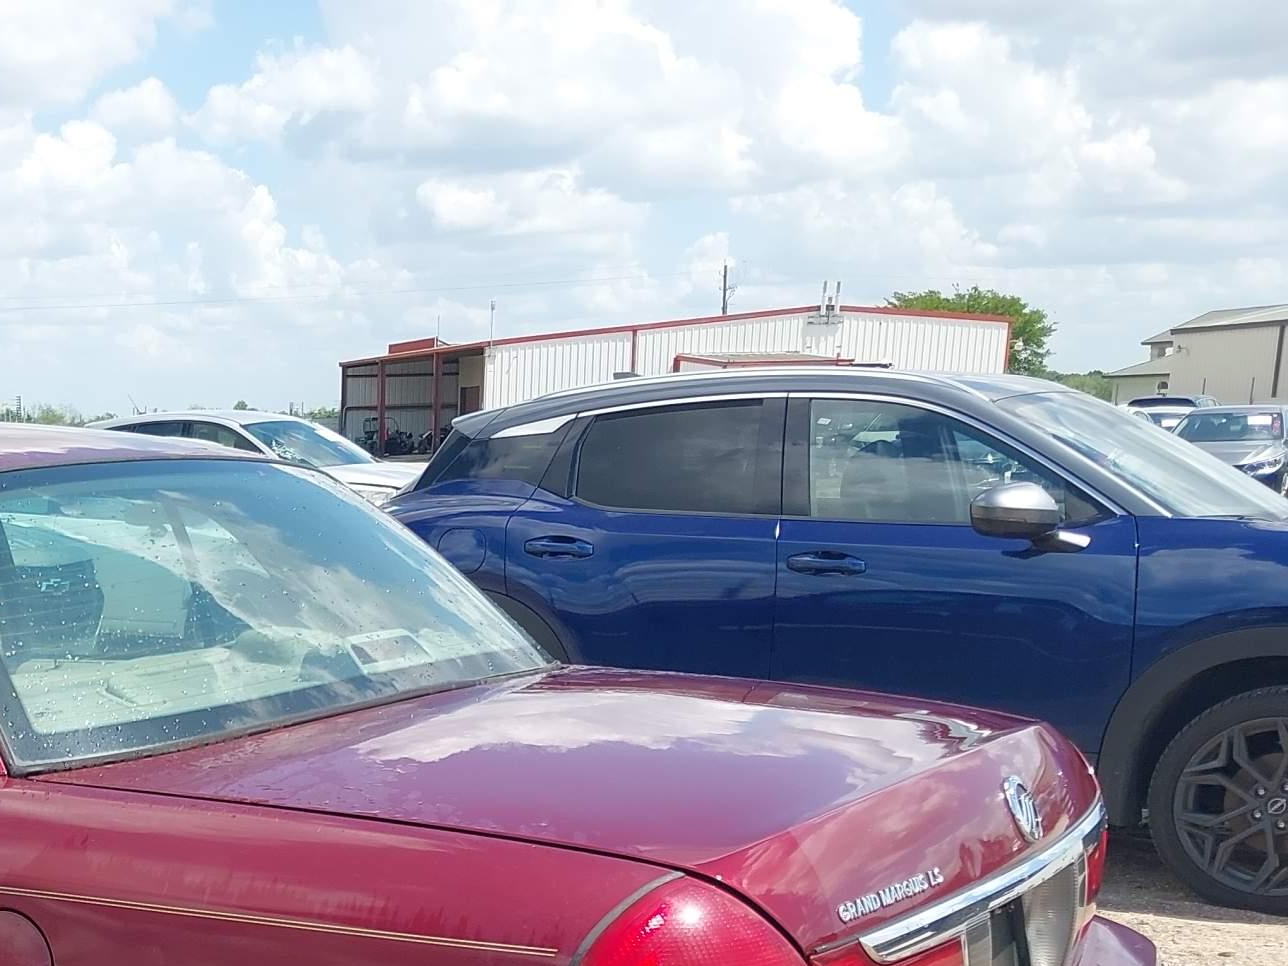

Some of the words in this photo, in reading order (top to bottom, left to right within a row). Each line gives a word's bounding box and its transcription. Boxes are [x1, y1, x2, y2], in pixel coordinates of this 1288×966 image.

[838, 894, 881, 923] GRAND
[879, 874, 929, 906] MARQUIS
[928, 867, 945, 887] LS
